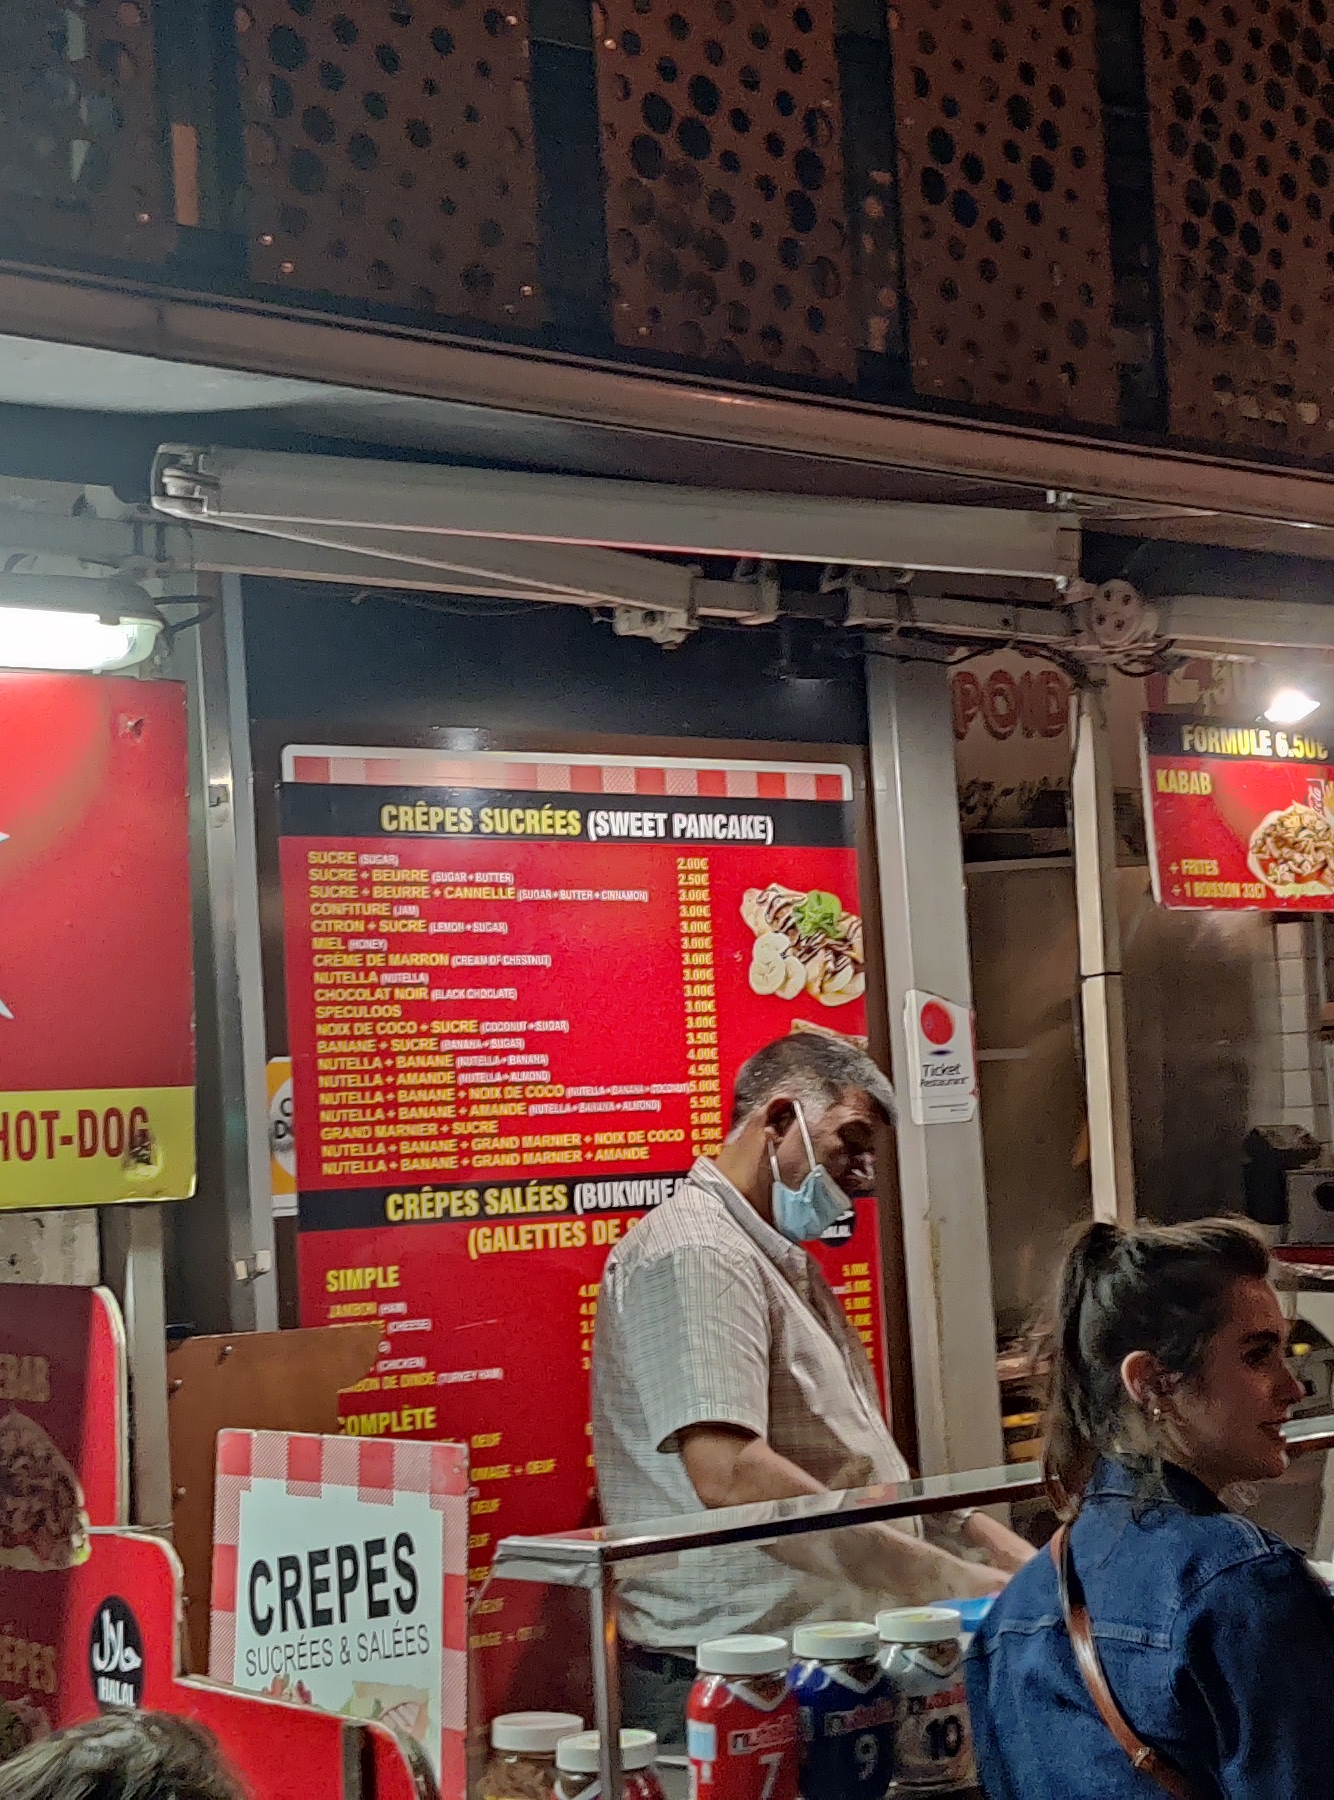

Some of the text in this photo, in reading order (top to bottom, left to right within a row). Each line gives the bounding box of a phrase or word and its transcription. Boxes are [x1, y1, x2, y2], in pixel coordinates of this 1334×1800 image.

[1182, 725, 1273, 757] FORMULE
[1156, 768, 1212, 795] KABAB
[381, 801, 774, 845] CRÊPES SUCRÉES (SWEET PANCAKE)
[308, 851, 399, 867] SUCRE (SUGAR)
[676, 857, 709, 871] 2.00€
[1180, 859, 1219, 876] FRITES
[308, 868, 514, 885] SUCRE BEURRE (SUGAR BUTTER)
[677, 873, 709, 886] 2.50€
[309, 885, 359, 898] SUCRE
[372, 886, 430, 899] BEURRE
[443, 886, 516, 900] CANNELLE
[558, 889, 593, 901] BUTTER
[678, 889, 711, 902] 3.00€
[1193, 882, 1241, 899] BOISSON
[310, 903, 419, 917] CONFITURE (JAM)
[679, 905, 711, 918] 3.00€
[311, 919, 364, 932] CITRON
[378, 919, 427, 932] SUCRE
[680, 920, 712, 933] 3.00€
[311, 937, 346, 950] MIEL
[681, 936, 713, 949] 3.00€
[366, 954, 386, 966] DE
[388, 953, 449, 967] MARRON
[682, 952, 713, 965] 3.00€
[314, 971, 378, 984] NUTELLA
[683, 968, 714, 981] 3.00€
[314, 988, 391, 1001] CHOCOLAT
[394, 988, 429, 1001] NOIR
[684, 984, 715, 997] 3.00€
[315, 1004, 402, 1018] SPECULOOS
[684, 1000, 716, 1013] 3.00€
[316, 1022, 352, 1036] NOIX
[354, 1022, 374, 1035] DE
[376, 1021, 417, 1035] COCO
[430, 1020, 478, 1034] SUCRE
[686, 1016, 717, 1029] 3.00€
[317, 1037, 438, 1054] BANANE SUCRE
[686, 1031, 718, 1045] 3.50€
[687, 1047, 719, 1060] 4.00€
[317, 1054, 454, 1071] NUTELLA BANANE
[688, 1063, 719, 1076] 4.50€
[922, 1062, 962, 1078] Ticket
[318, 1071, 455, 1088] NUTELLA AMANDE
[689, 1079, 720, 1092] 5.00€
[319, 1084, 565, 1105] NUTELLA BANANE NOIX DE COCO
[690, 1095, 721, 1109] 5.50€
[320, 1103, 527, 1122] NUTELLA BANANE AMANDE
[691, 1111, 722, 1125] 5.00€
[321, 1120, 499, 1140] GRAND MARNIER SUCRE
[321, 1129, 685, 1157] NUTELLA BANANE GRAND MARNIER NOIX DE COCO
[322, 1147, 650, 1175] NUTELLA BANANE GRAND MARNIER AMANDE
[385, 1177, 691, 1222] CRÊPES SALÉES (BUKWHEA
[468, 1218, 622, 1260] (GALETTES DE
[326, 1265, 400, 1292] SIMPLE
[248, 1531, 419, 1637] CREPES
[245, 1634, 335, 1676] SUCRÉES
[338, 1640, 352, 1664] &
[355, 1622, 430, 1663] SALÉES
[98, 1676, 137, 1707] HALAL
[926, 1715, 963, 1760] 10
[854, 1734, 879, 1781] 9
[759, 1752, 785, 1800] 7
